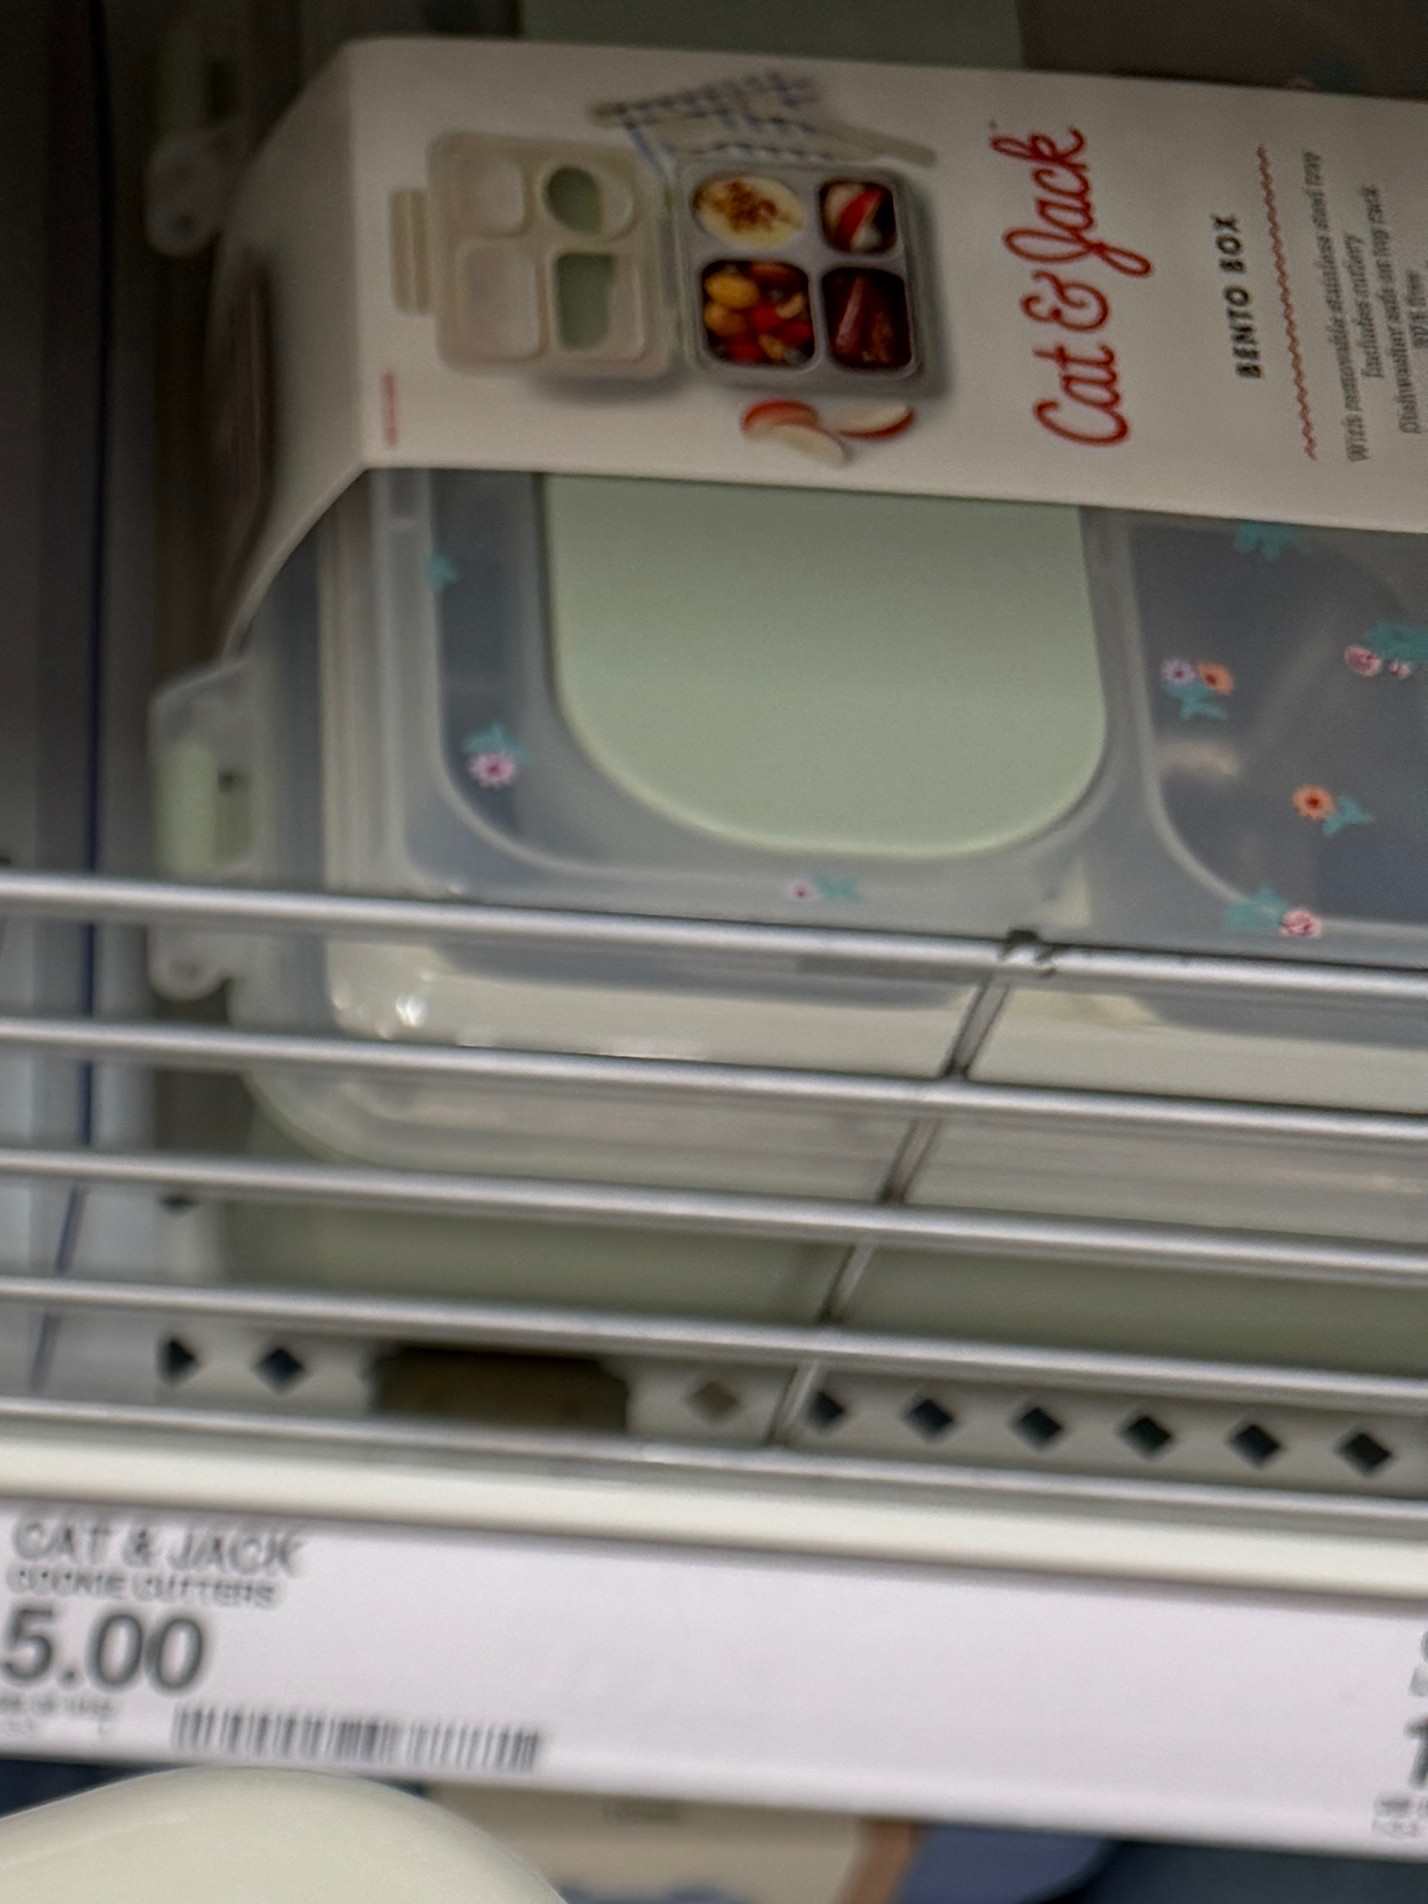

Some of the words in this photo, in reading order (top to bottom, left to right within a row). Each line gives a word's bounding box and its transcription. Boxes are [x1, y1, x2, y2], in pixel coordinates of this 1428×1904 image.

[988, 126, 1154, 278] Jack
[1211, 213, 1247, 274] BOX
[1020, 269, 1111, 333] &
[1222, 285, 1263, 379] BENTO
[1033, 343, 1130, 447] Cat
[12, 1519, 112, 1562] CAT
[122, 1522, 153, 1568] &
[165, 1527, 303, 1578] JACK
